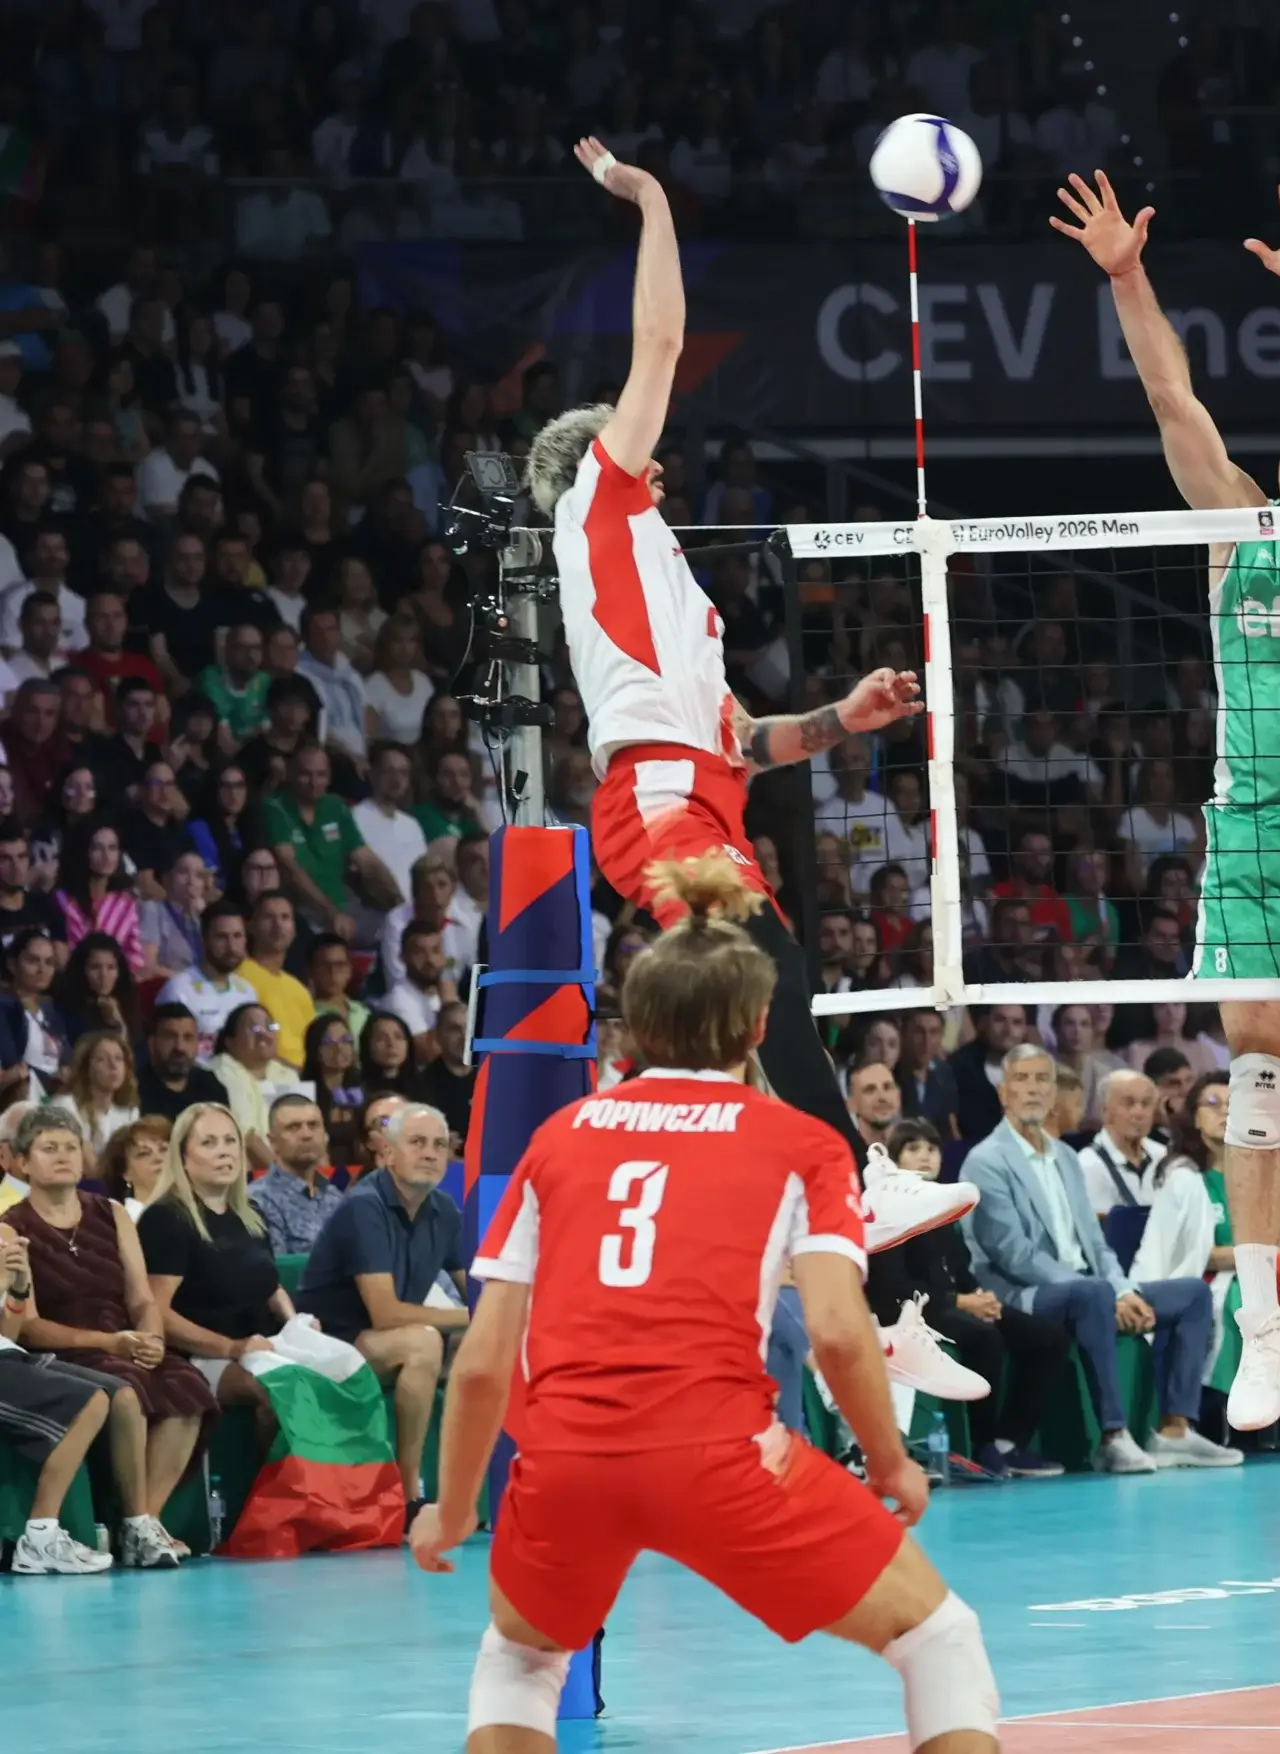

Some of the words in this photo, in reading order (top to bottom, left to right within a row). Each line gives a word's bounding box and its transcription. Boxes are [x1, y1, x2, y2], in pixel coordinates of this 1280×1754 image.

[816, 282, 1055, 382] CEV
[834, 533, 864, 545] CEV
[893, 527, 914, 544] CE
[969, 522, 1053, 544] EuroVolley
[1058, 520, 1098, 538] 2026
[1103, 519, 1139, 536] Men
[572, 1098, 745, 1133] POPIWCZAK
[598, 1160, 670, 1288] 3
